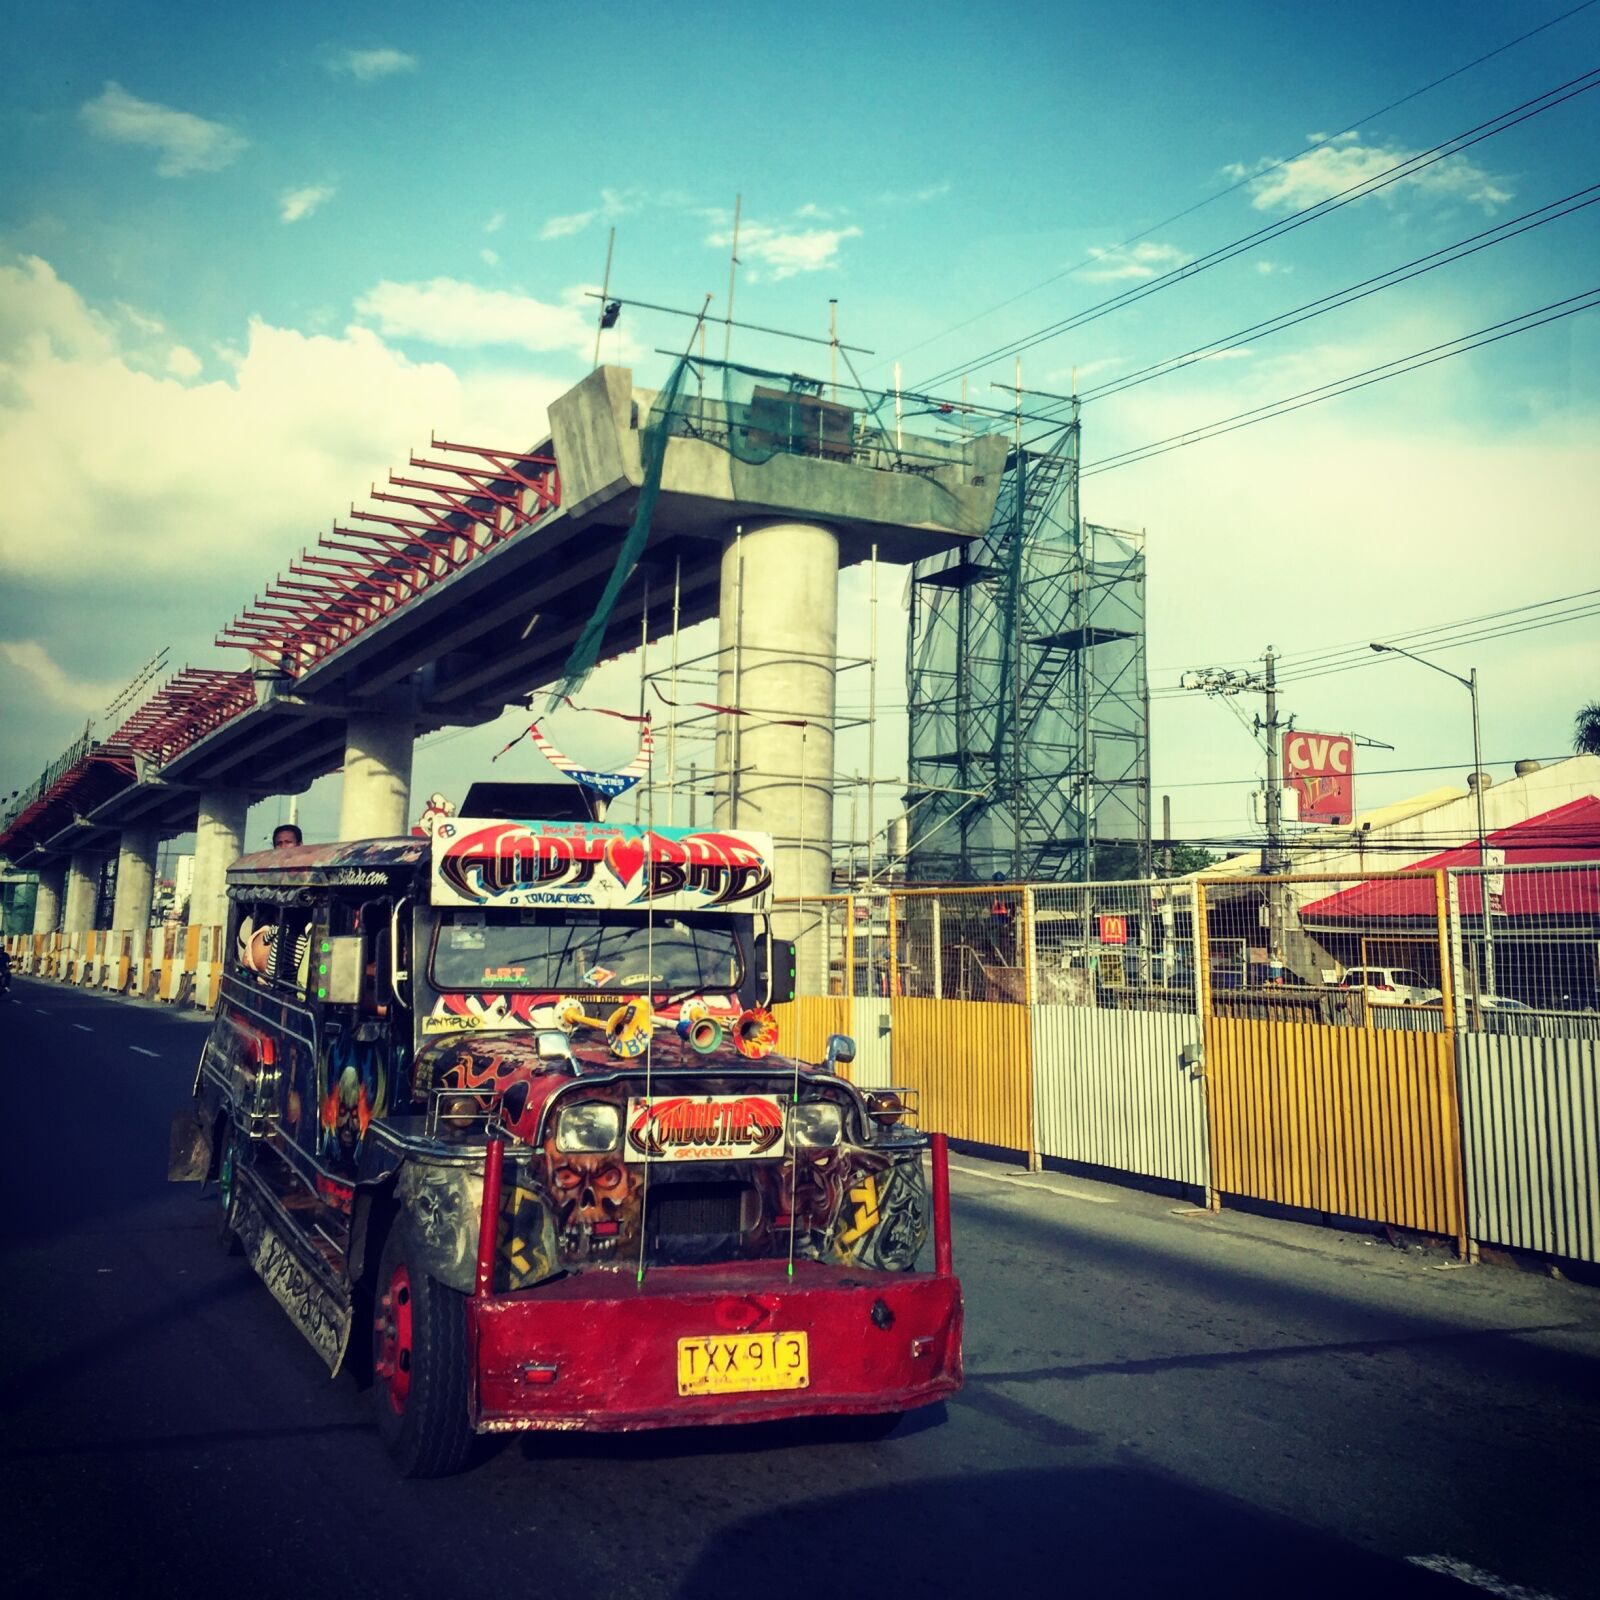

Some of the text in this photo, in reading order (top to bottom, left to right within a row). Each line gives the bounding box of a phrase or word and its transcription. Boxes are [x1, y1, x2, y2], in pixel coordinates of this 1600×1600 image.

[1288, 737, 1349, 774] CVC
[524, 892, 595, 905] CONDUCTRESS
[674, 1147, 733, 1158] BEVERLY
[684, 1340, 801, 1374] TXX 913
